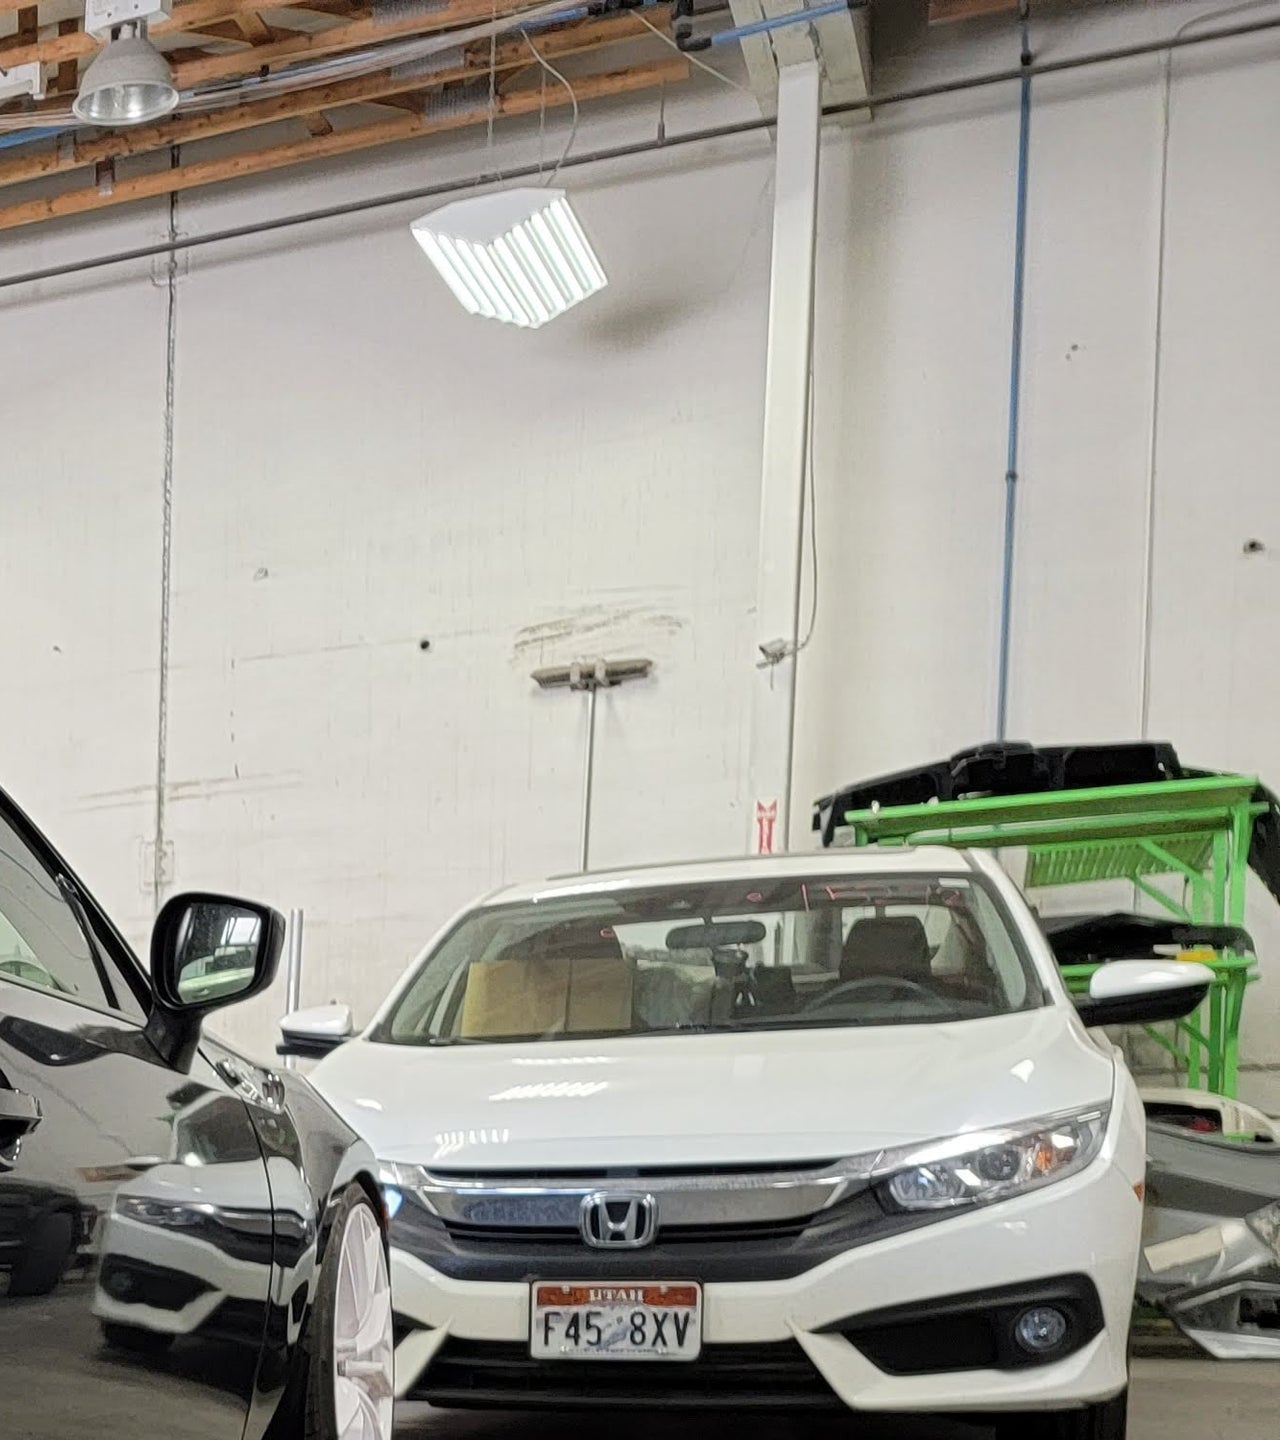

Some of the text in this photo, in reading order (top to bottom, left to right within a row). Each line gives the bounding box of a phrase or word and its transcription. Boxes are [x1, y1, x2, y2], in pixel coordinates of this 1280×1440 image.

[589, 1289, 644, 1302] UTAH
[543, 1311, 689, 1346] F45 8XV
